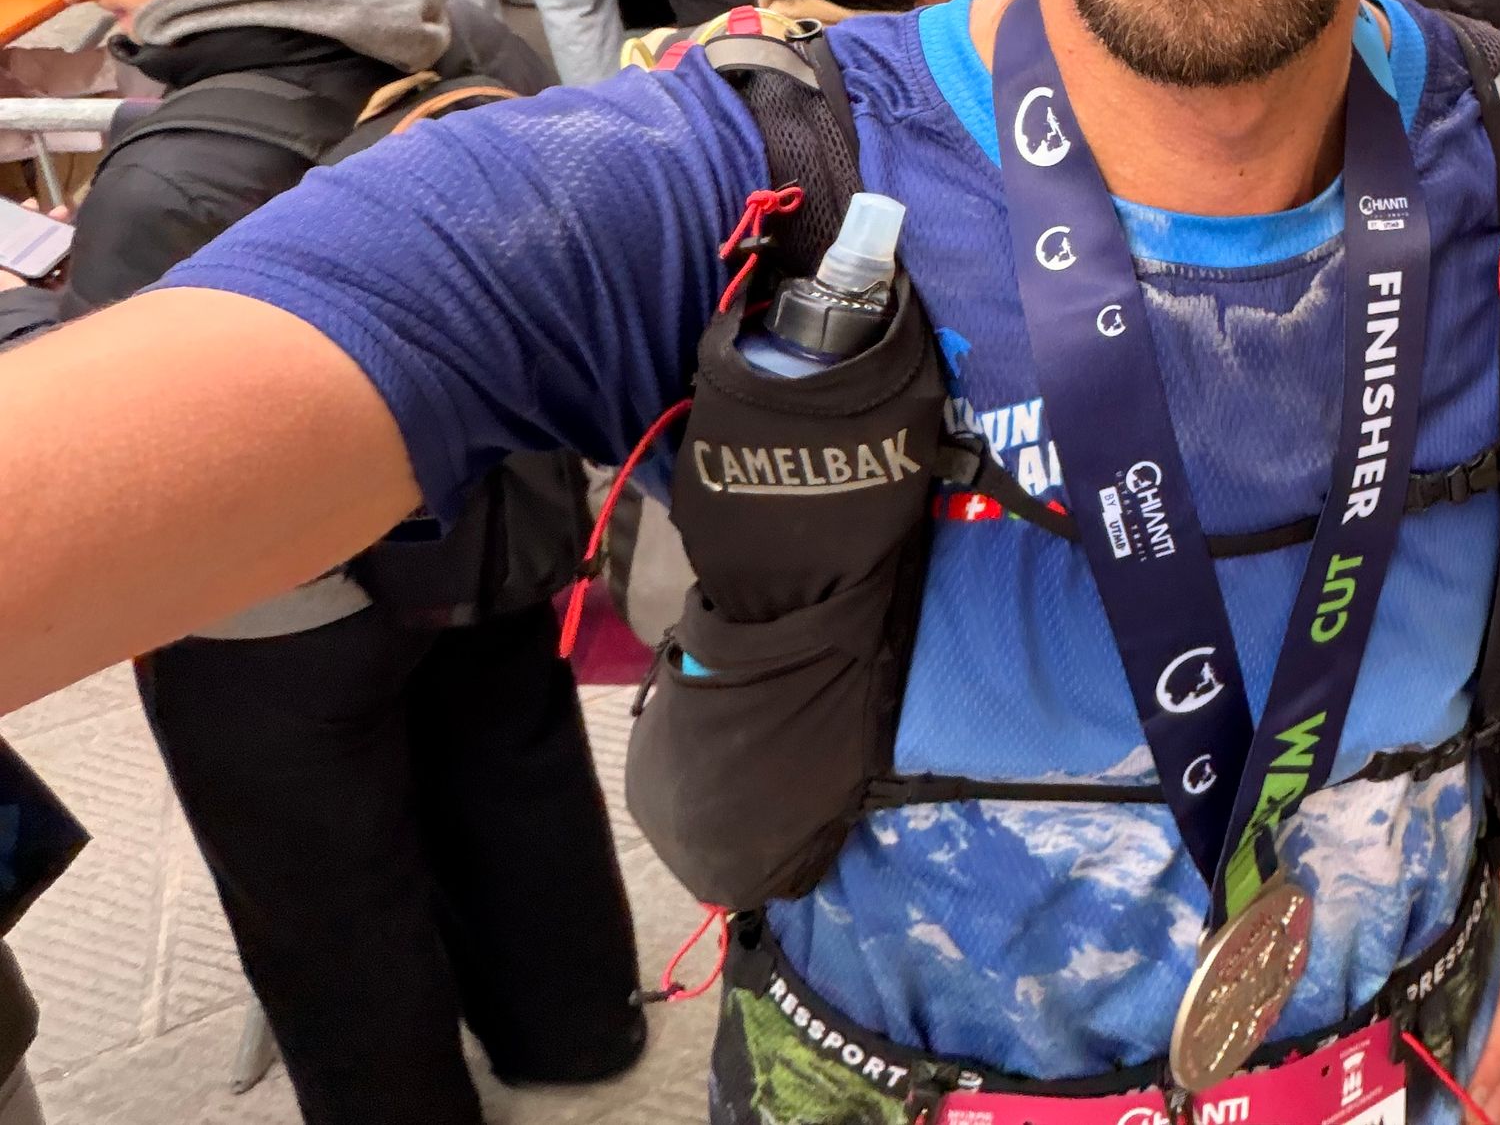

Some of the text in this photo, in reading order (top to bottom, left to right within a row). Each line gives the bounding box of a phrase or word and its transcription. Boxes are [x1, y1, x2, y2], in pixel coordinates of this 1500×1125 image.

[1359, 195, 1409, 216] CHIANTI
[1342, 271, 1404, 526] FINISHER
[693, 428, 922, 492] CAMELBAK
[1104, 493, 1117, 507] BY
[1126, 460, 1176, 559] CHIANTI
[1311, 553, 1364, 644] CUT
[768, 973, 909, 1088] RESSPORT
